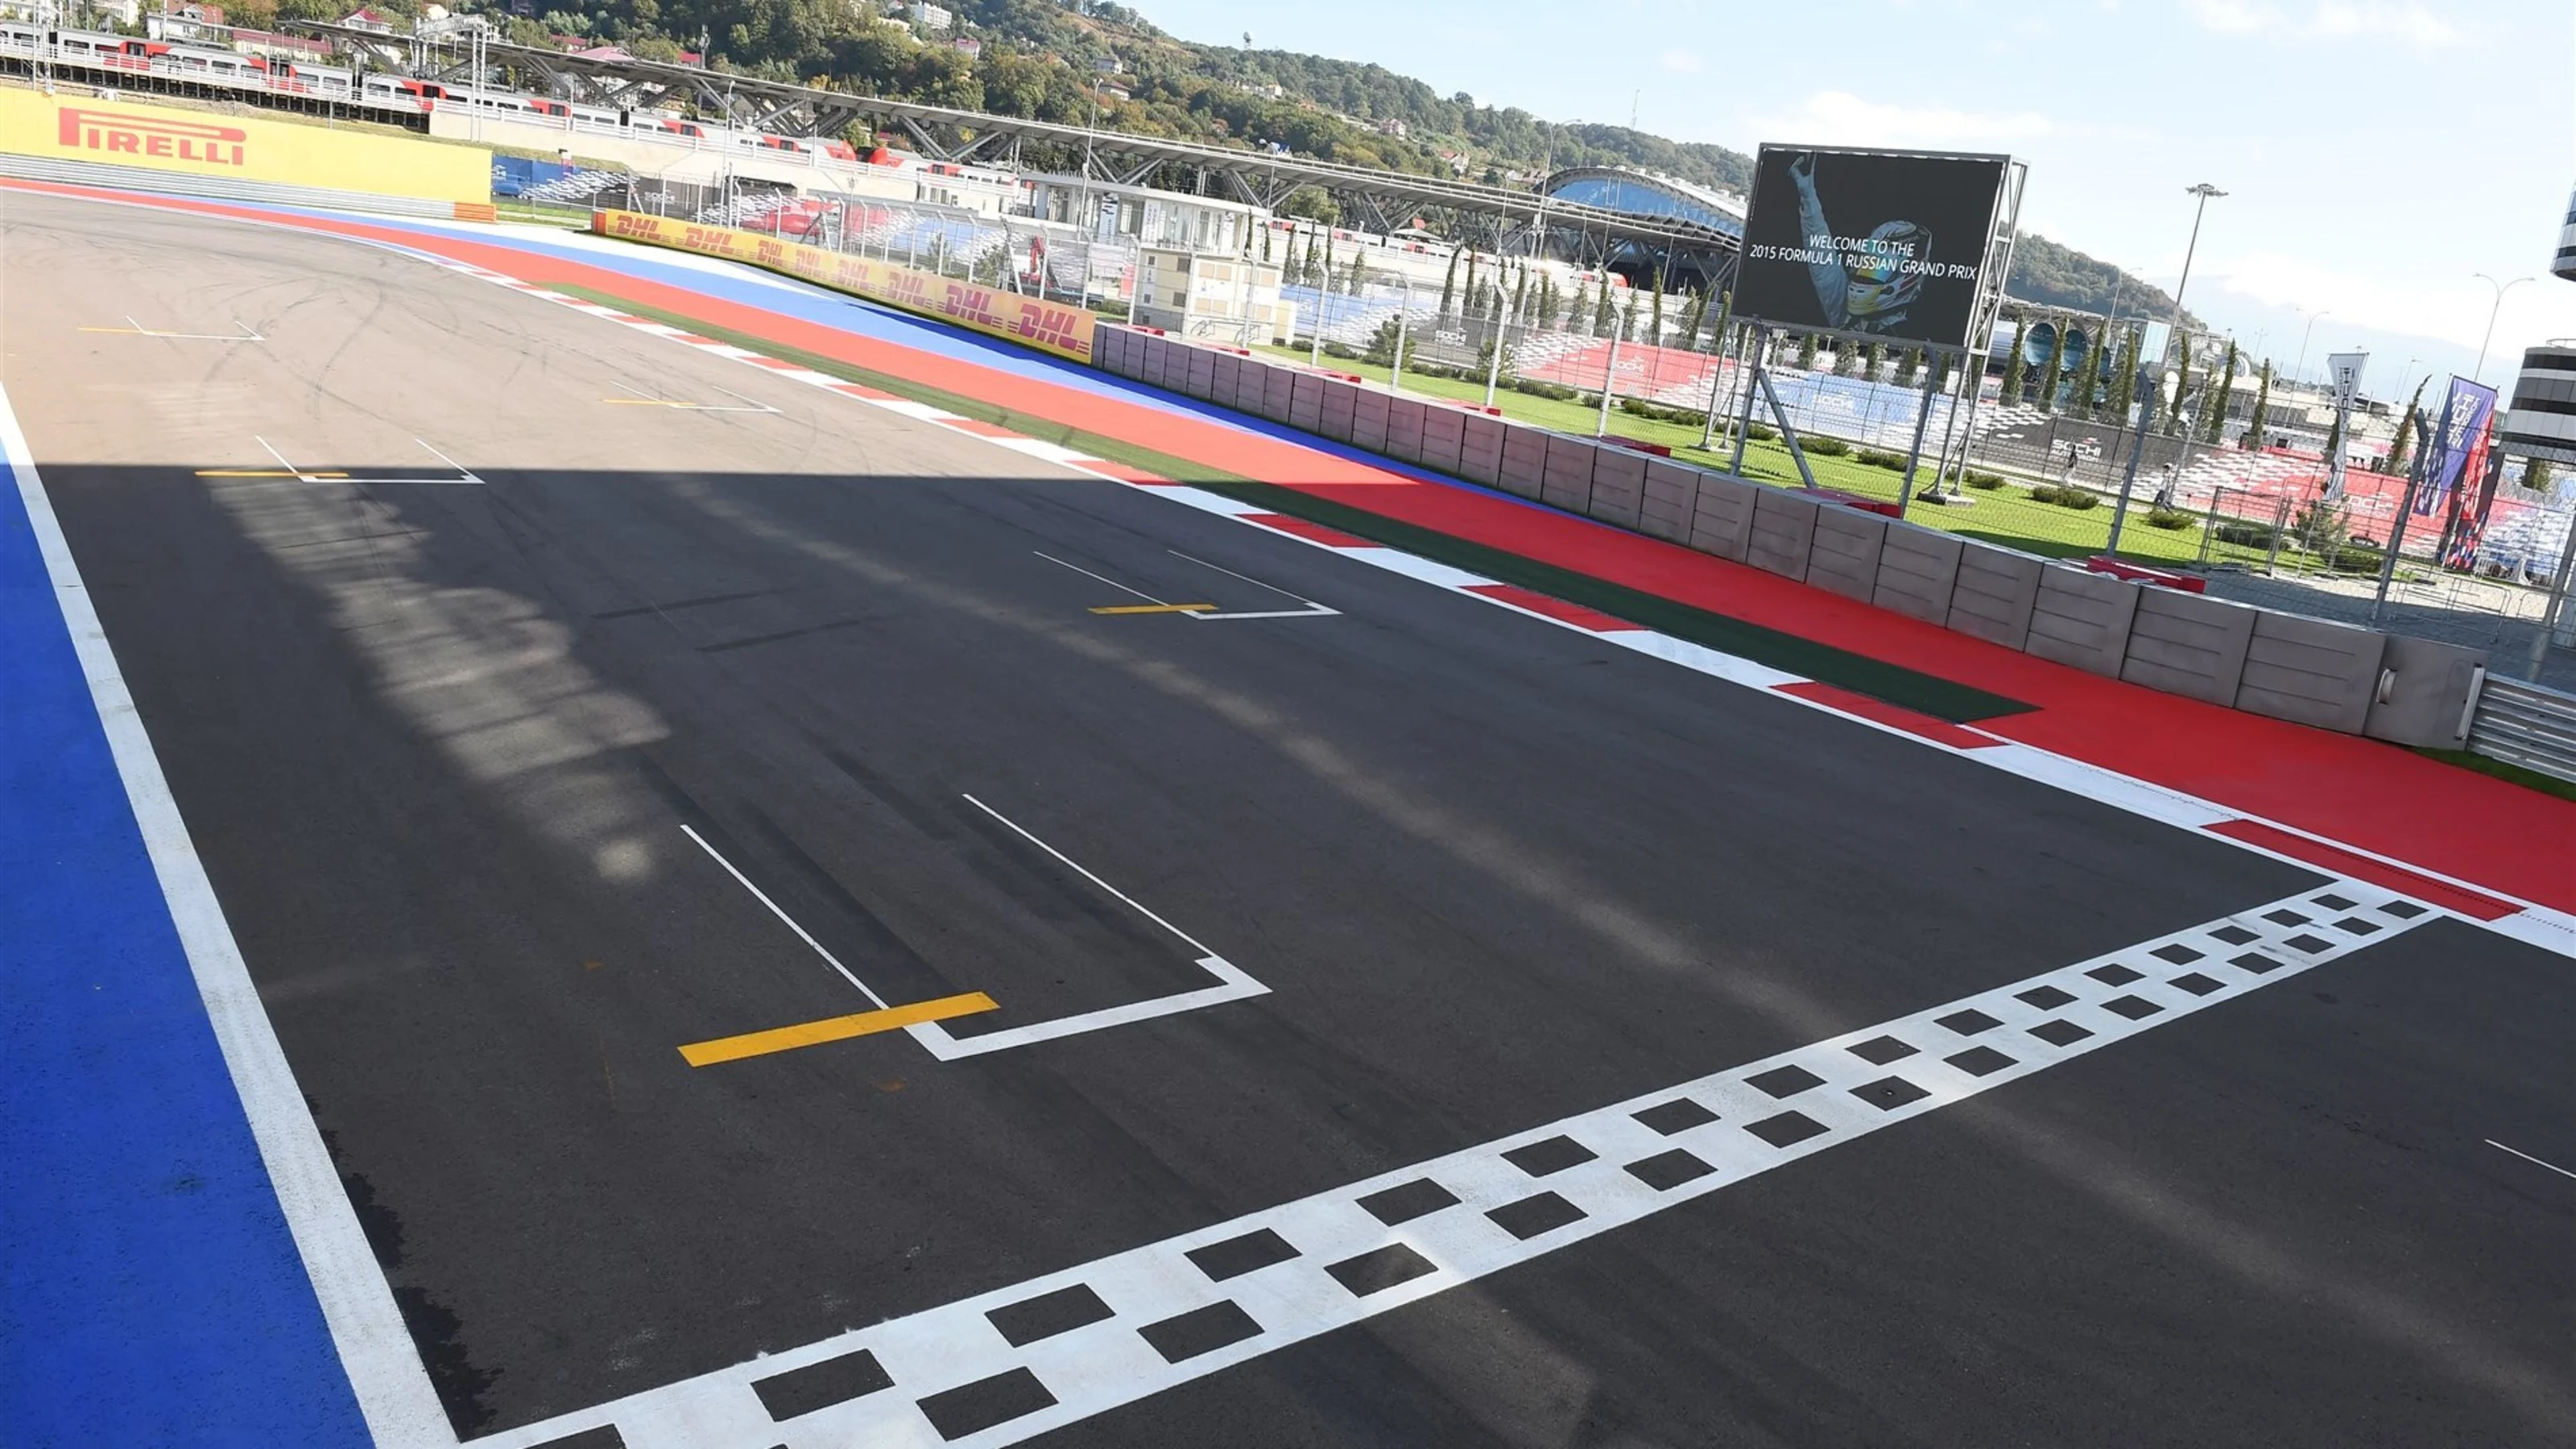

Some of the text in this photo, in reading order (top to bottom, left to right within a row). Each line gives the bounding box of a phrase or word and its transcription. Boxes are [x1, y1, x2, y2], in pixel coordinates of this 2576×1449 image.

[59, 107, 246, 166] PIRELLI
[616, 215, 660, 240] DHL
[684, 226, 735, 254] DHL
[756, 240, 783, 266] DHL
[1809, 234, 1915, 257] WELCOME TO THE
[794, 250, 823, 277] DHL
[837, 258, 870, 291] DHL
[1750, 244, 1978, 280] 2015 FORMULA 1 RUSSIAN GRAND PRIX
[887, 271, 925, 307] DHL
[945, 284, 992, 325] DHL
[1019, 303, 1078, 351] DHL
[2052, 439, 2102, 456] SOCHI
